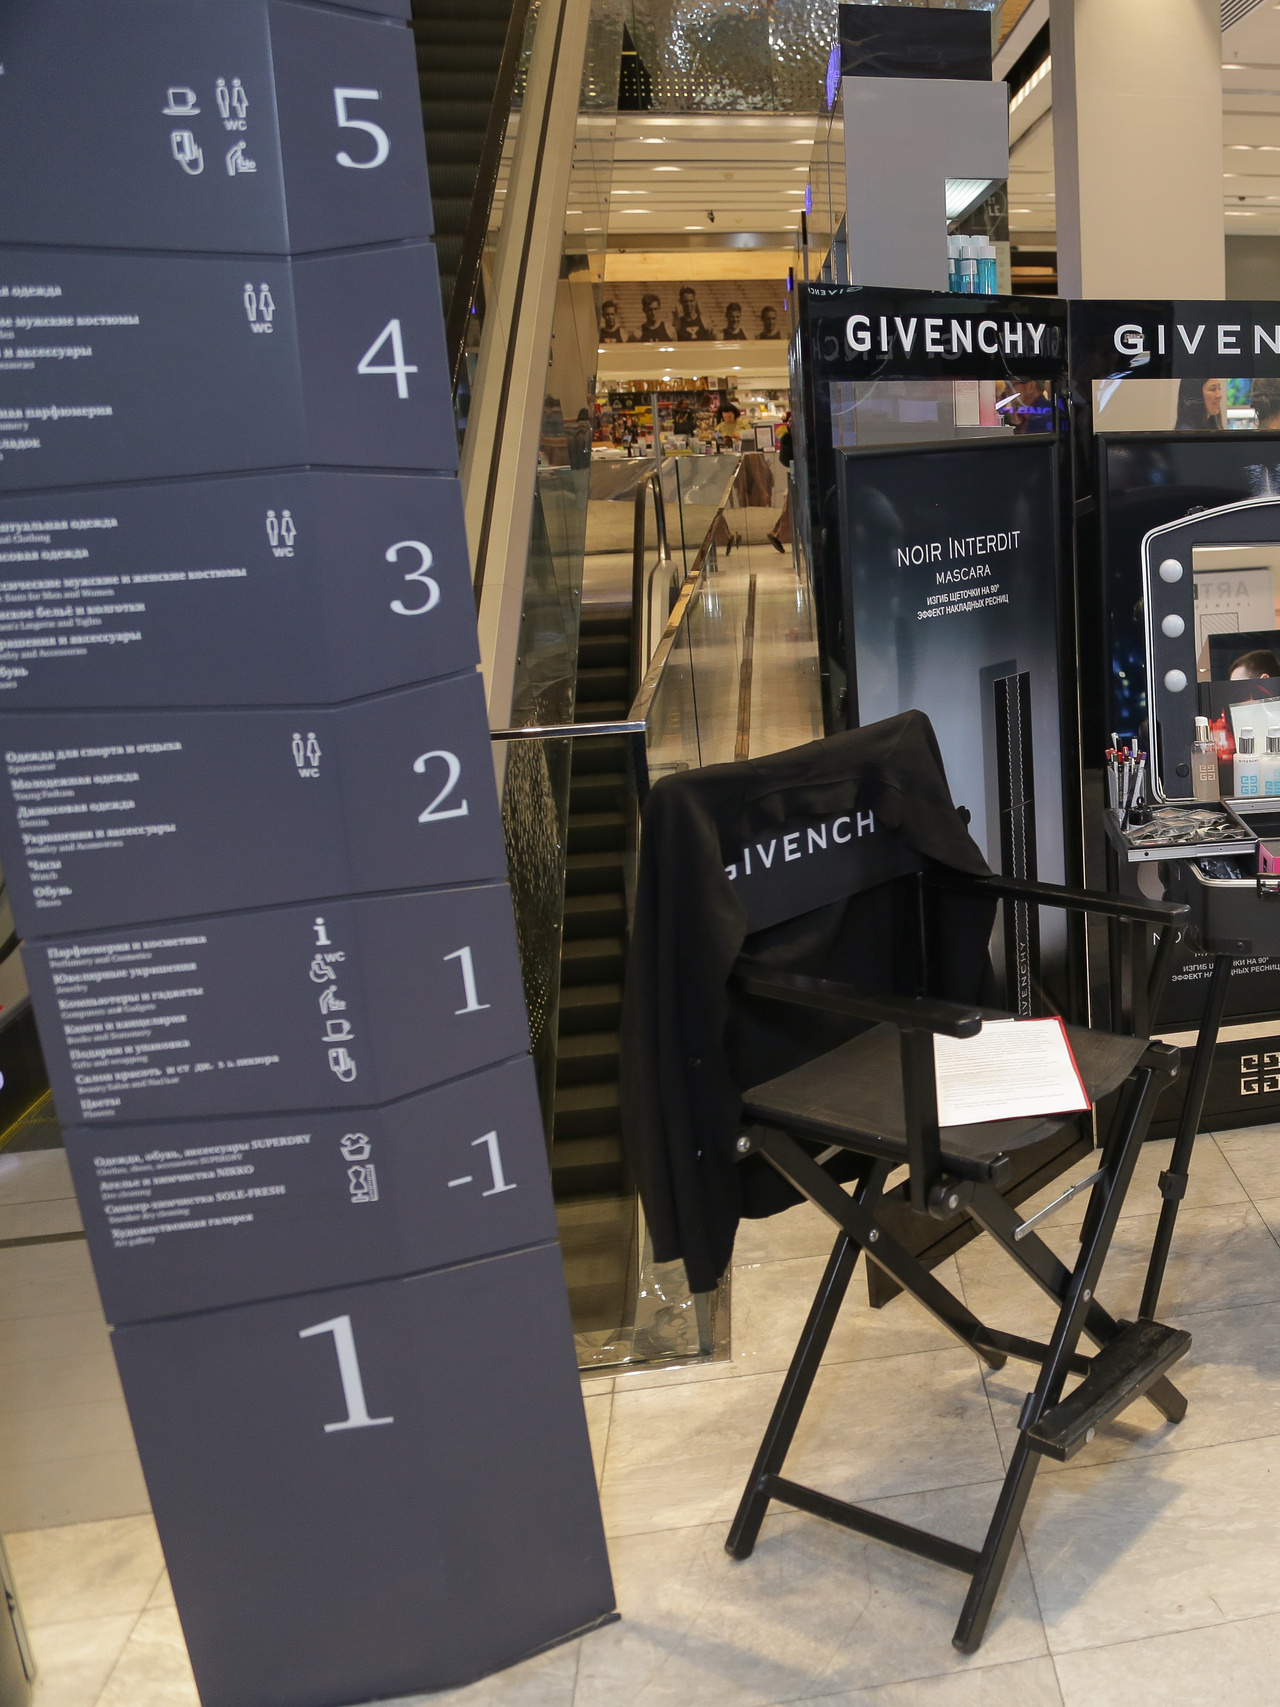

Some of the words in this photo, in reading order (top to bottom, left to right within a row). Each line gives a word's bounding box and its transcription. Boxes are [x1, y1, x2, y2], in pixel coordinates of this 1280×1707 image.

[223, 118, 247, 131] WC
[333, 87, 390, 169] 5
[250, 322, 273, 333] WC
[846, 315, 1046, 355] GIVENCHY
[357, 318, 418, 400] 4
[272, 547, 295, 558] WC
[897, 543, 942, 567] NOIR
[385, 540, 441, 616] 3
[936, 564, 992, 585] MASCARA
[926, 593, 949, 605] ИЗГИБ
[949, 588, 981, 601] ЩЕТОЧКИ
[981, 586, 990, 594] НА
[917, 607, 945, 620] ЭФФЕКТ
[946, 599, 984, 614] НАКЛАДНЫХ
[985, 594, 1009, 607] РЕСНИЦ
[299, 768, 320, 778] WC
[413, 750, 469, 823] 2
[325, 951, 346, 963] WC
[1182, 963, 1208, 972] ИЗГИБ
[1246, 960, 1256, 968] НА
[443, 946, 491, 1016] 1
[1172, 972, 1201, 982] ЭФФЕКТ
[1250, 965, 1280, 974] РЕСНИЦ
[250, 1134, 312, 1150] SUPERDRY
[448, 1130, 517, 1197] -1
[299, 1315, 394, 1433] 1
